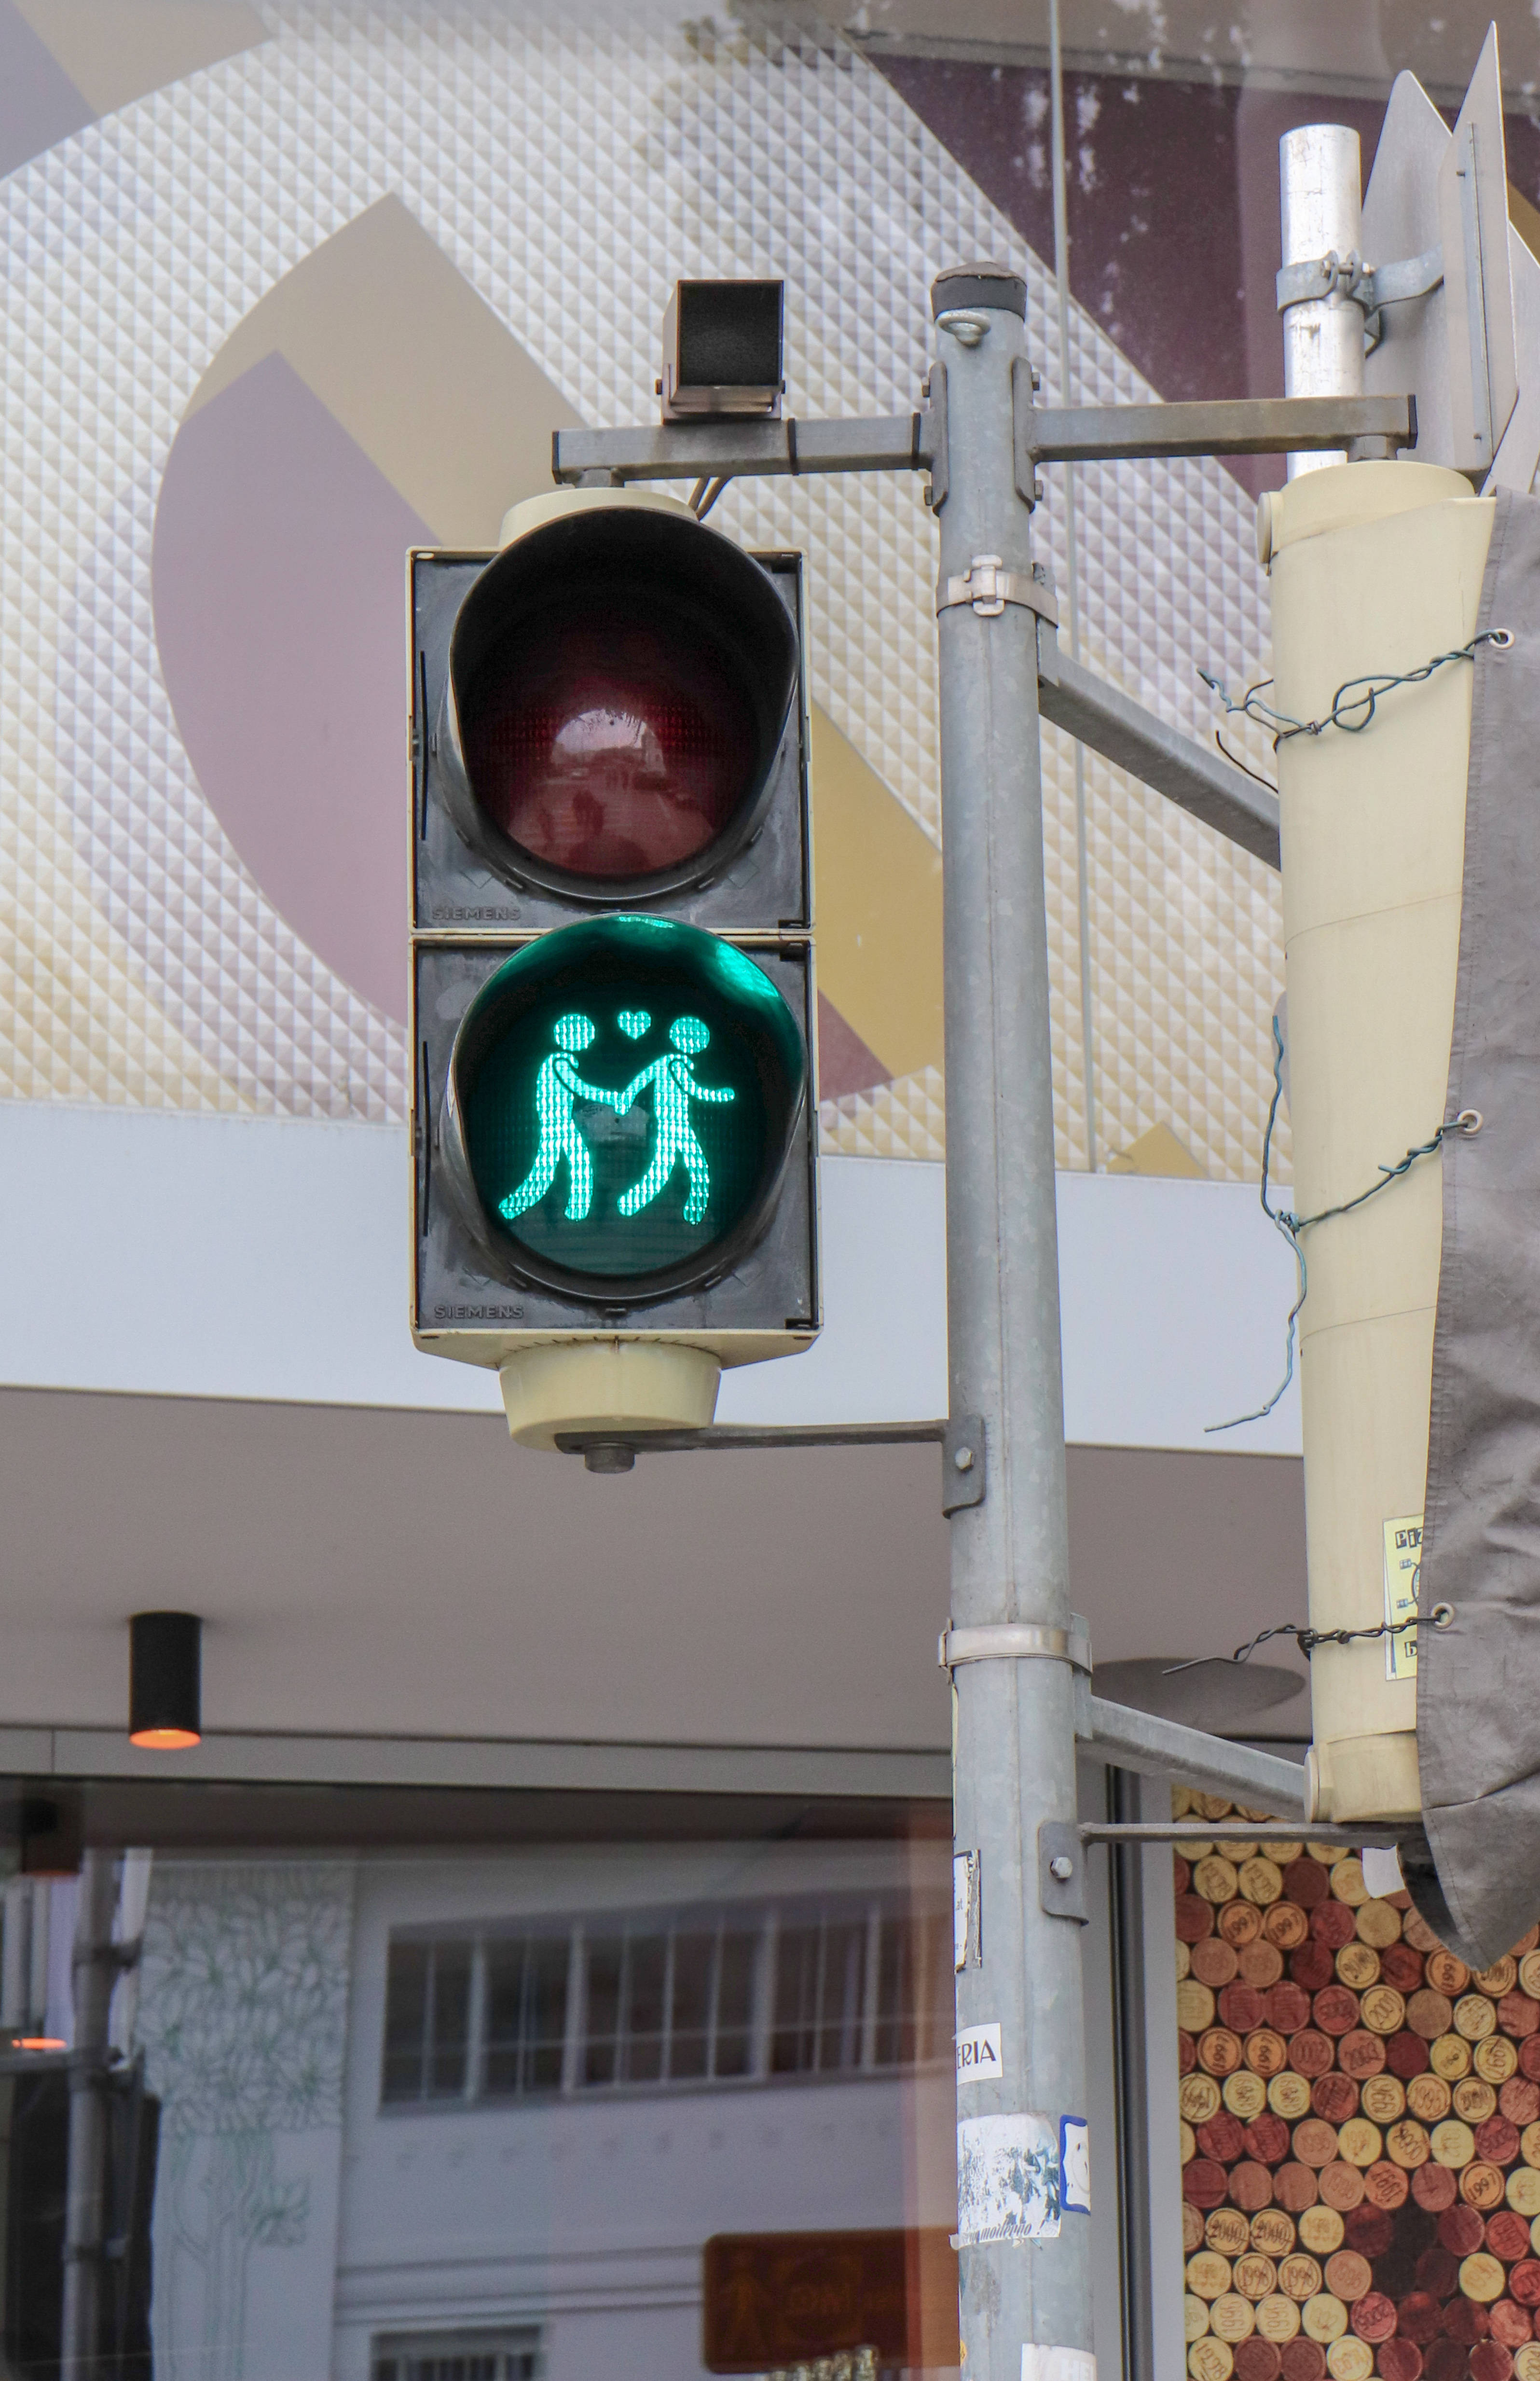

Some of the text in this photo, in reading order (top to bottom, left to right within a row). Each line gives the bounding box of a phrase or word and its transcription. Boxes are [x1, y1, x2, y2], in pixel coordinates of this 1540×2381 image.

[432, 906, 521, 920] SIEMENS
[435, 1305, 524, 1319] SIEMENS
[1213, 2035, 1229, 2069] 1997
[1257, 2036, 1272, 2070] 1997
[1469, 2172, 1496, 2200] 1997
